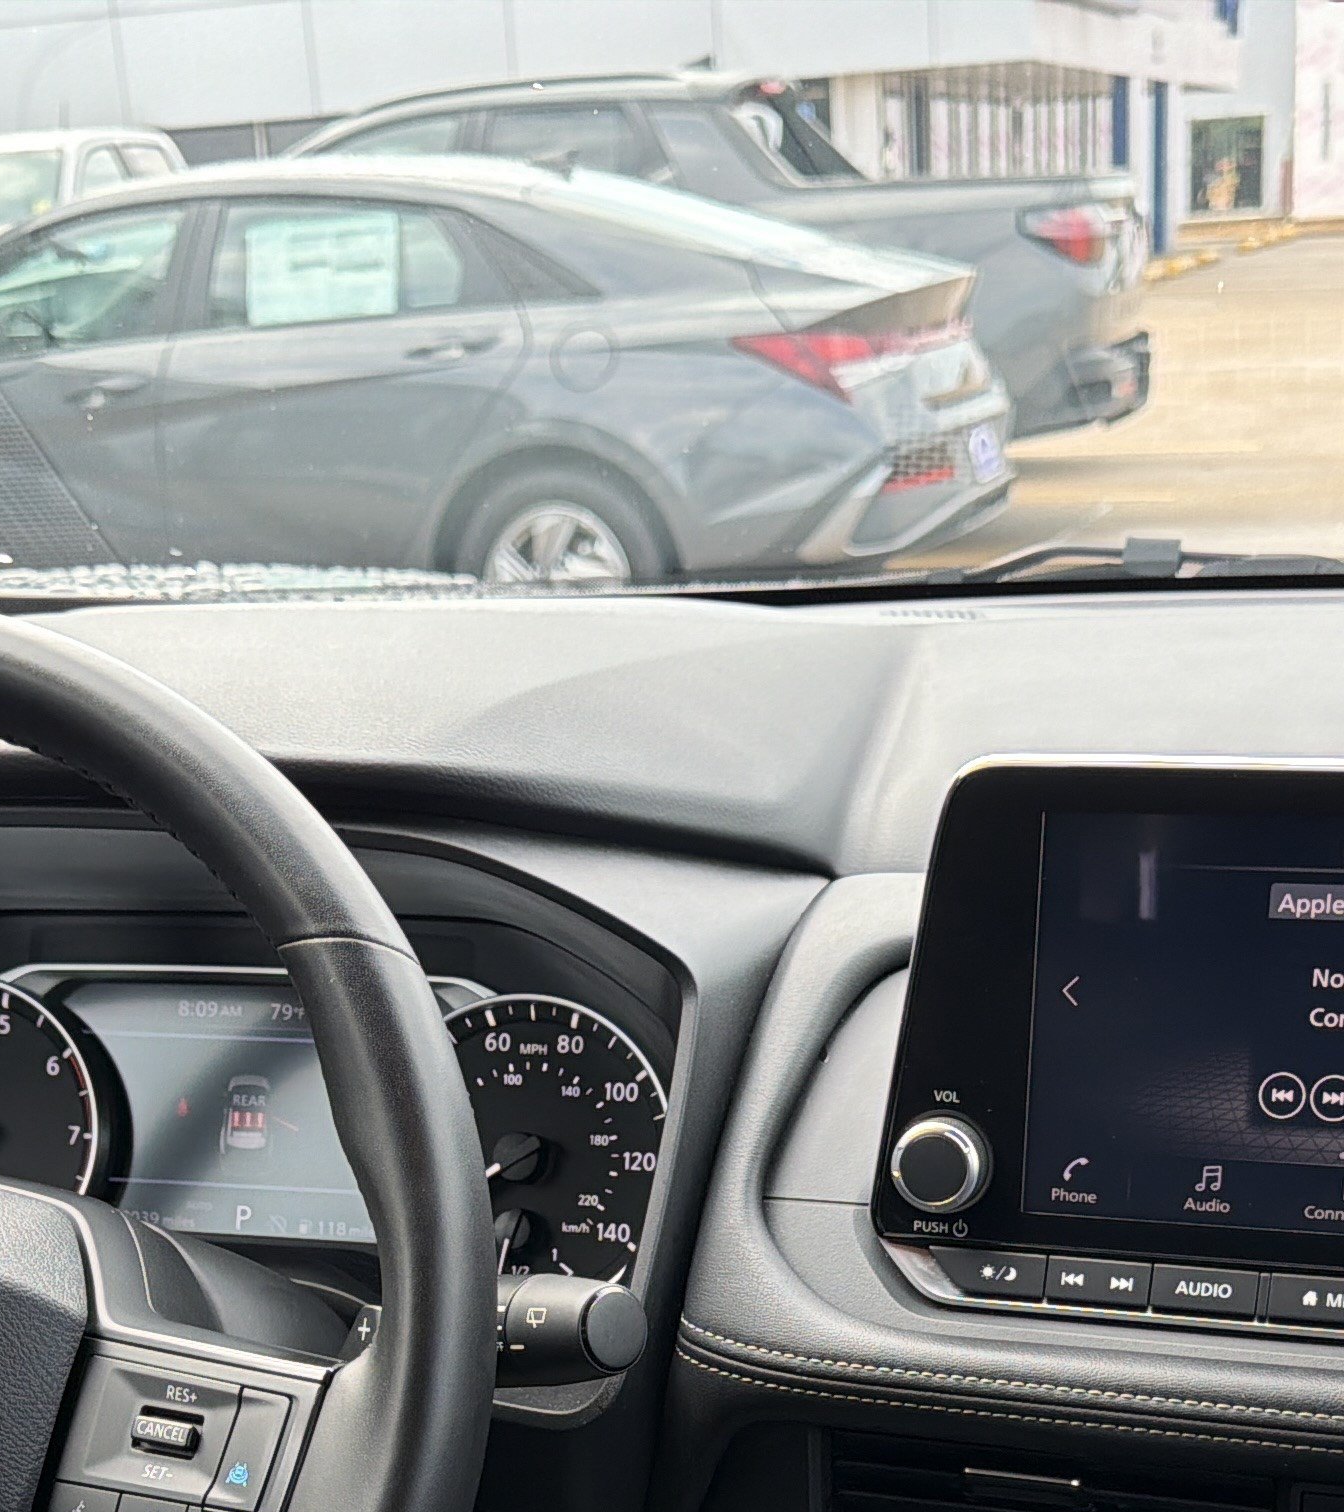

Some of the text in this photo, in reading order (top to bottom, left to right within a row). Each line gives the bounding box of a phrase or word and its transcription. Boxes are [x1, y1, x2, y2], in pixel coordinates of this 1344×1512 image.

[177, 1000, 243, 1017] 8:09 AM
[485, 1032, 511, 1052] 60
[519, 1042, 548, 1056] MPH
[556, 1035, 584, 1055] 80
[46, 1056, 60, 1076] 6
[503, 1074, 523, 1087] 100
[232, 1094, 267, 1108] REAR
[561, 1085, 581, 1098] 140
[604, 1081, 640, 1103] 100
[933, 1088, 961, 1104] VOL
[67, 1125, 81, 1146] 7
[589, 1134, 609, 1147] 180
[622, 1151, 656, 1172] 120
[577, 1194, 599, 1207] 220
[1050, 1186, 1098, 1205] Phone
[1182, 1196, 1231, 1214] Audio
[235, 1204, 253, 1231] P
[596, 1222, 631, 1243] 140
[912, 1219, 949, 1236] PUSH
[1174, 1279, 1233, 1300] AUDIO
[165, 1384, 198, 1403] RES+
[136, 1419, 187, 1443] CANCEL
